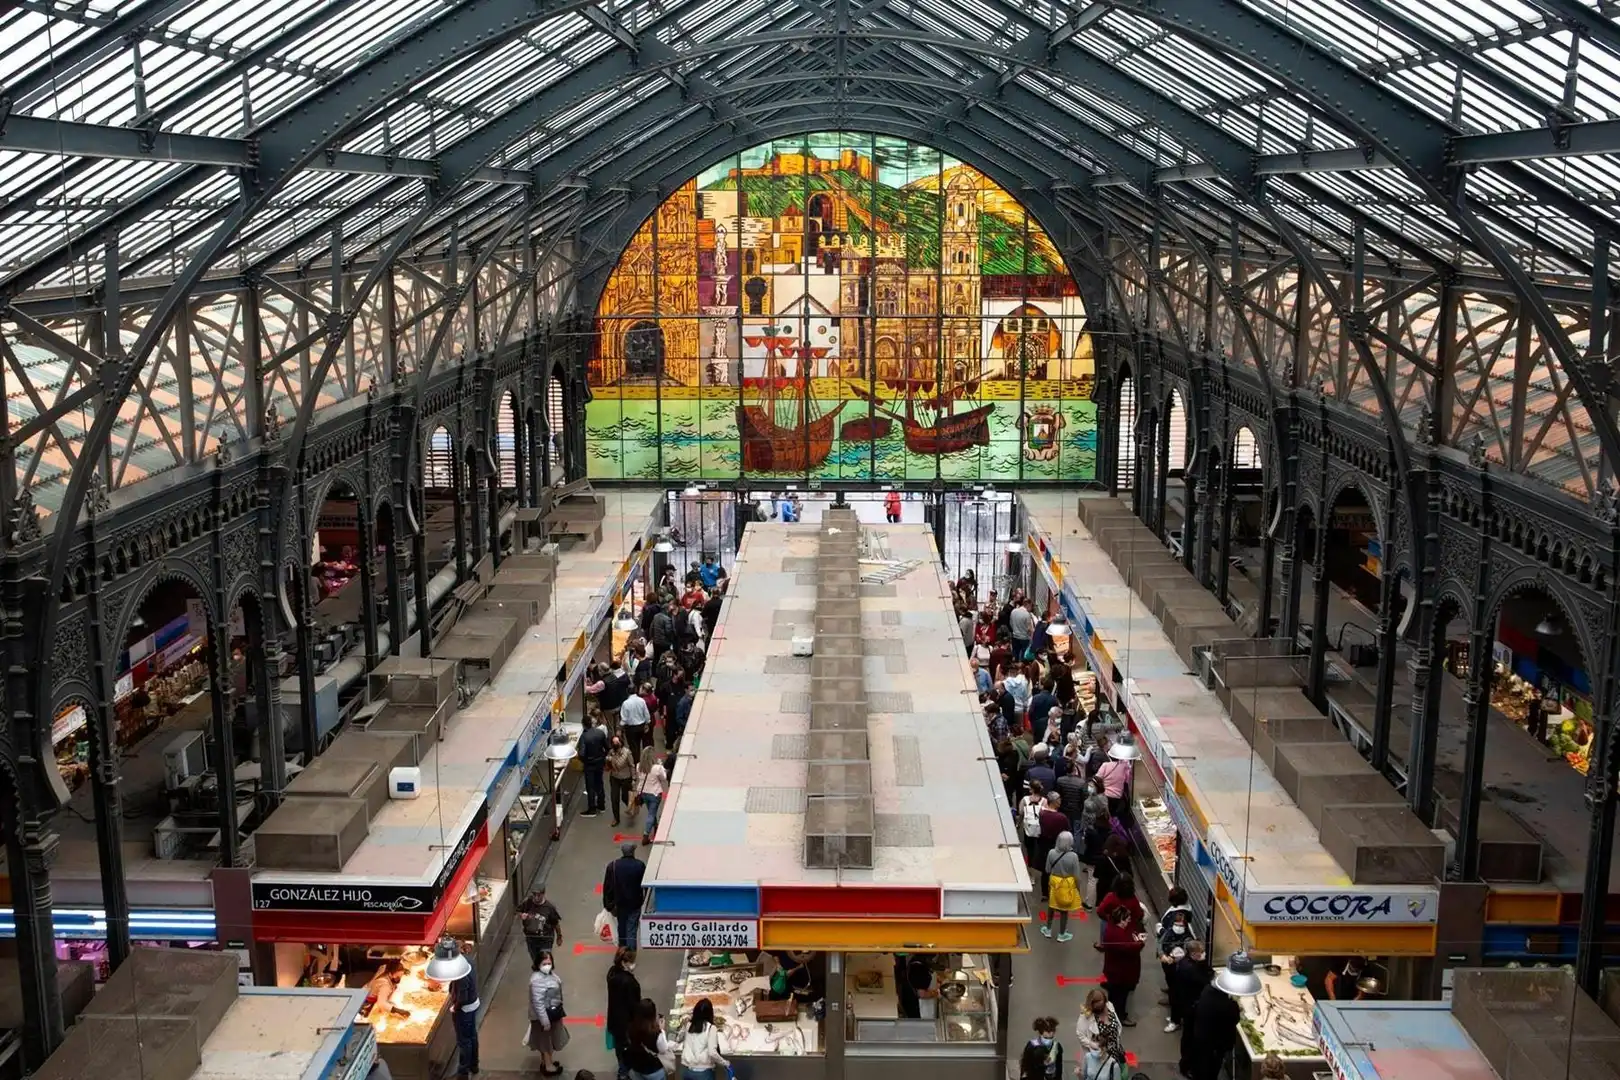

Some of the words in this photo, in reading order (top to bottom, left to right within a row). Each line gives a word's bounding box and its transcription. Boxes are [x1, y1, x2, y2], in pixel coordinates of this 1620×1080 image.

[1210, 841, 1240, 900] COCORA
[270, 887, 340, 901] GONZÁLEZ
[343, 889, 372, 902] HIJO
[255, 900, 270, 909] 127
[1264, 895, 1391, 920] COCORA
[649, 921, 687, 932] Pedro
[691, 922, 749, 932] Gallardo
[649, 933, 664, 947] 625
[665, 934, 680, 946] 477
[681, 934, 696, 946] 520
[701, 934, 716, 947] 695
[717, 934, 732, 947] 354
[733, 934, 749, 947] 704
